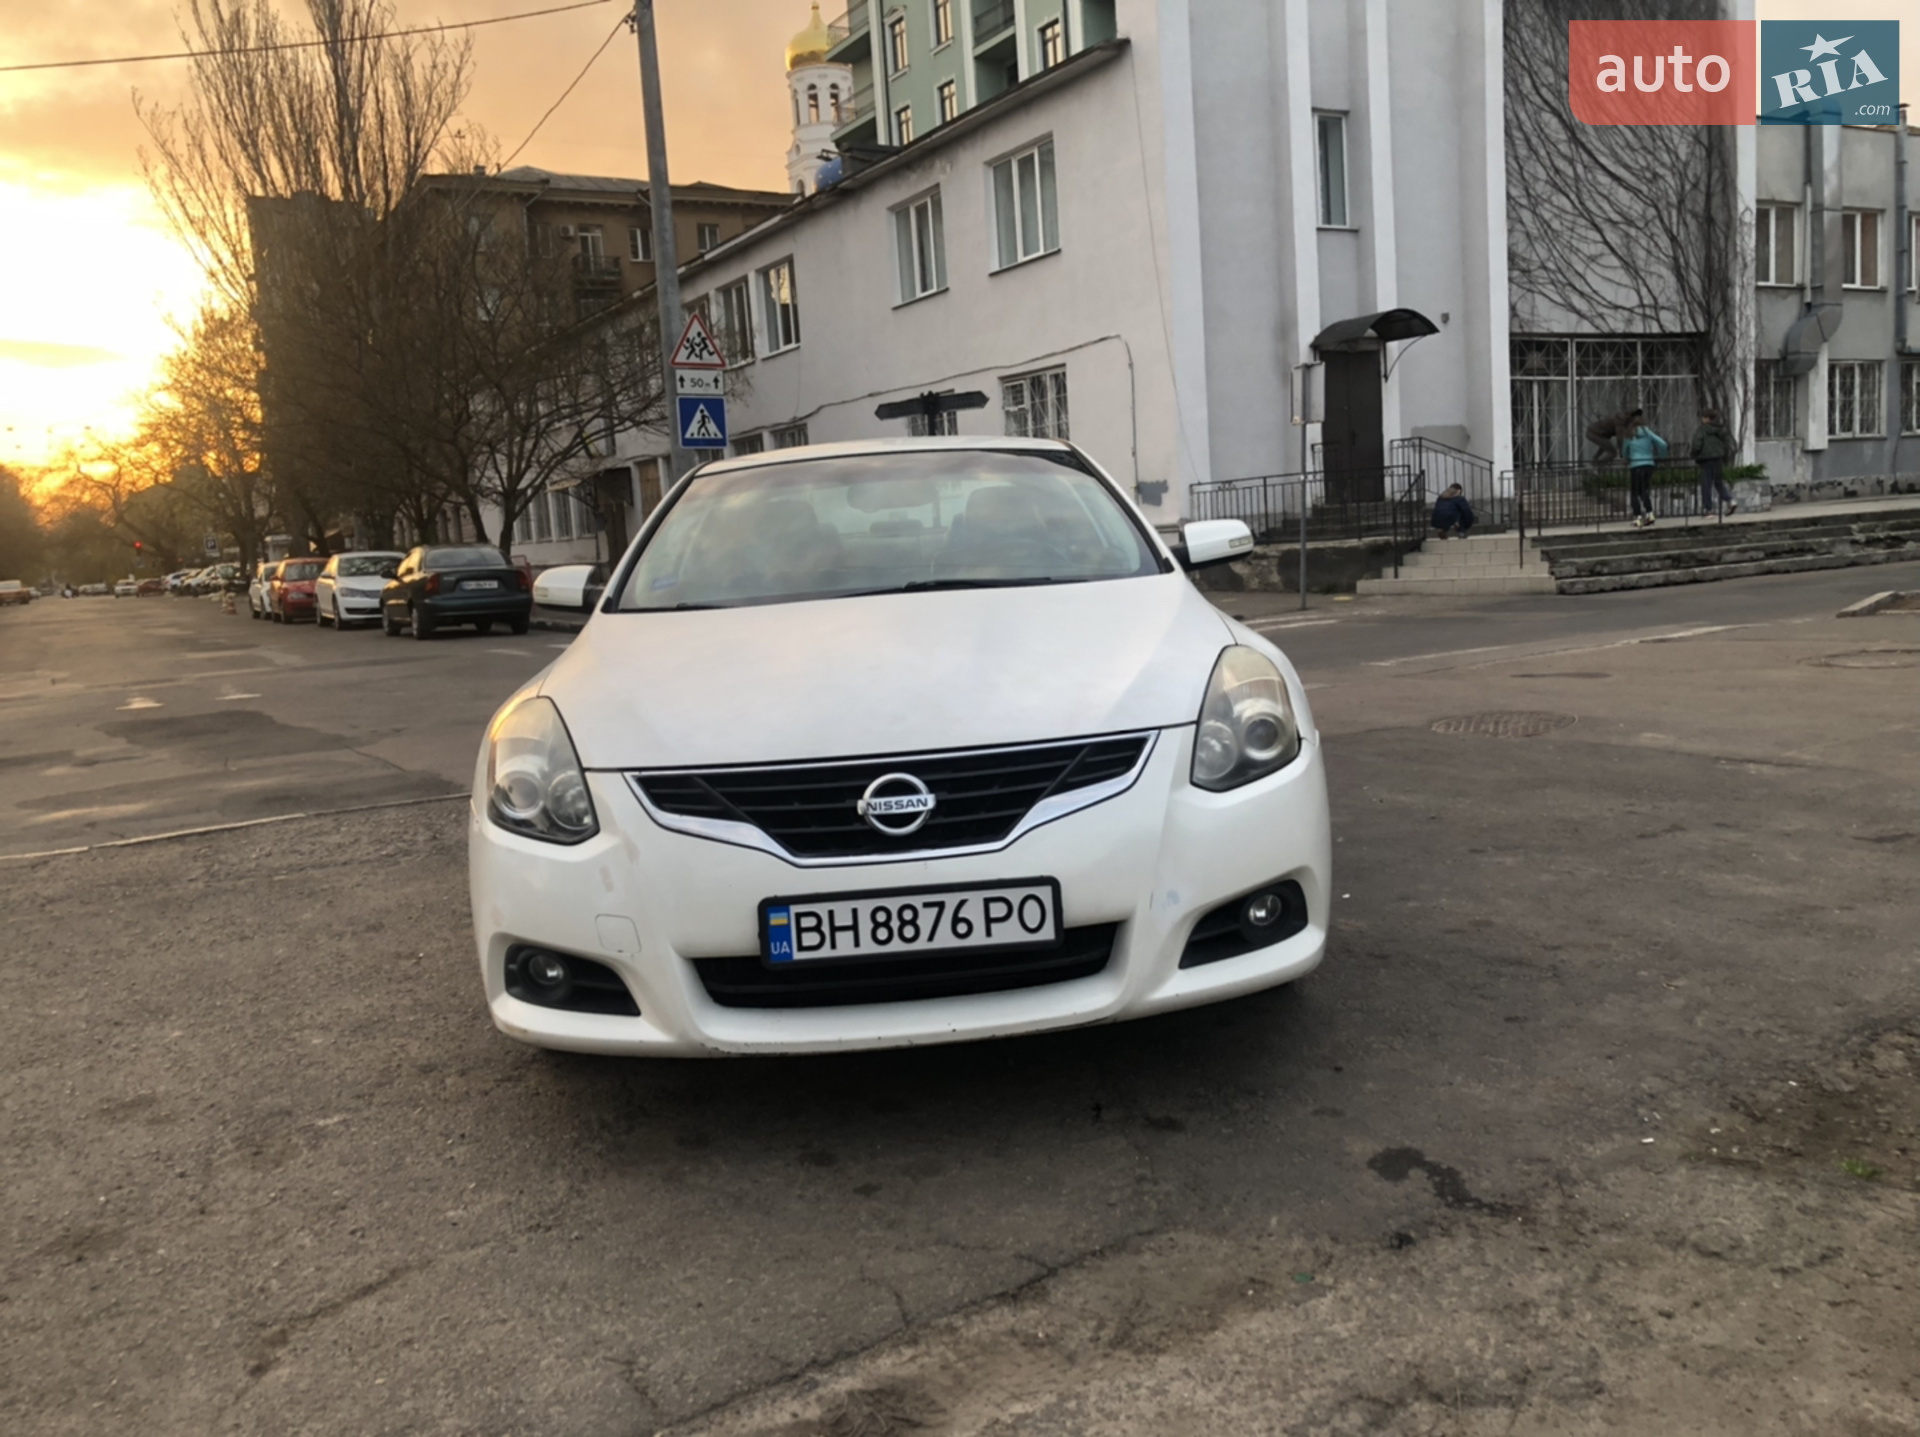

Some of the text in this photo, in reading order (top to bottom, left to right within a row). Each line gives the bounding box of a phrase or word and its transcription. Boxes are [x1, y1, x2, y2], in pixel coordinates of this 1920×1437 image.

[690, 377, 704, 388] 50
[866, 797, 928, 812] NISSAN
[794, 893, 1047, 953] BH 8876 PO
[770, 940, 791, 955] UA
